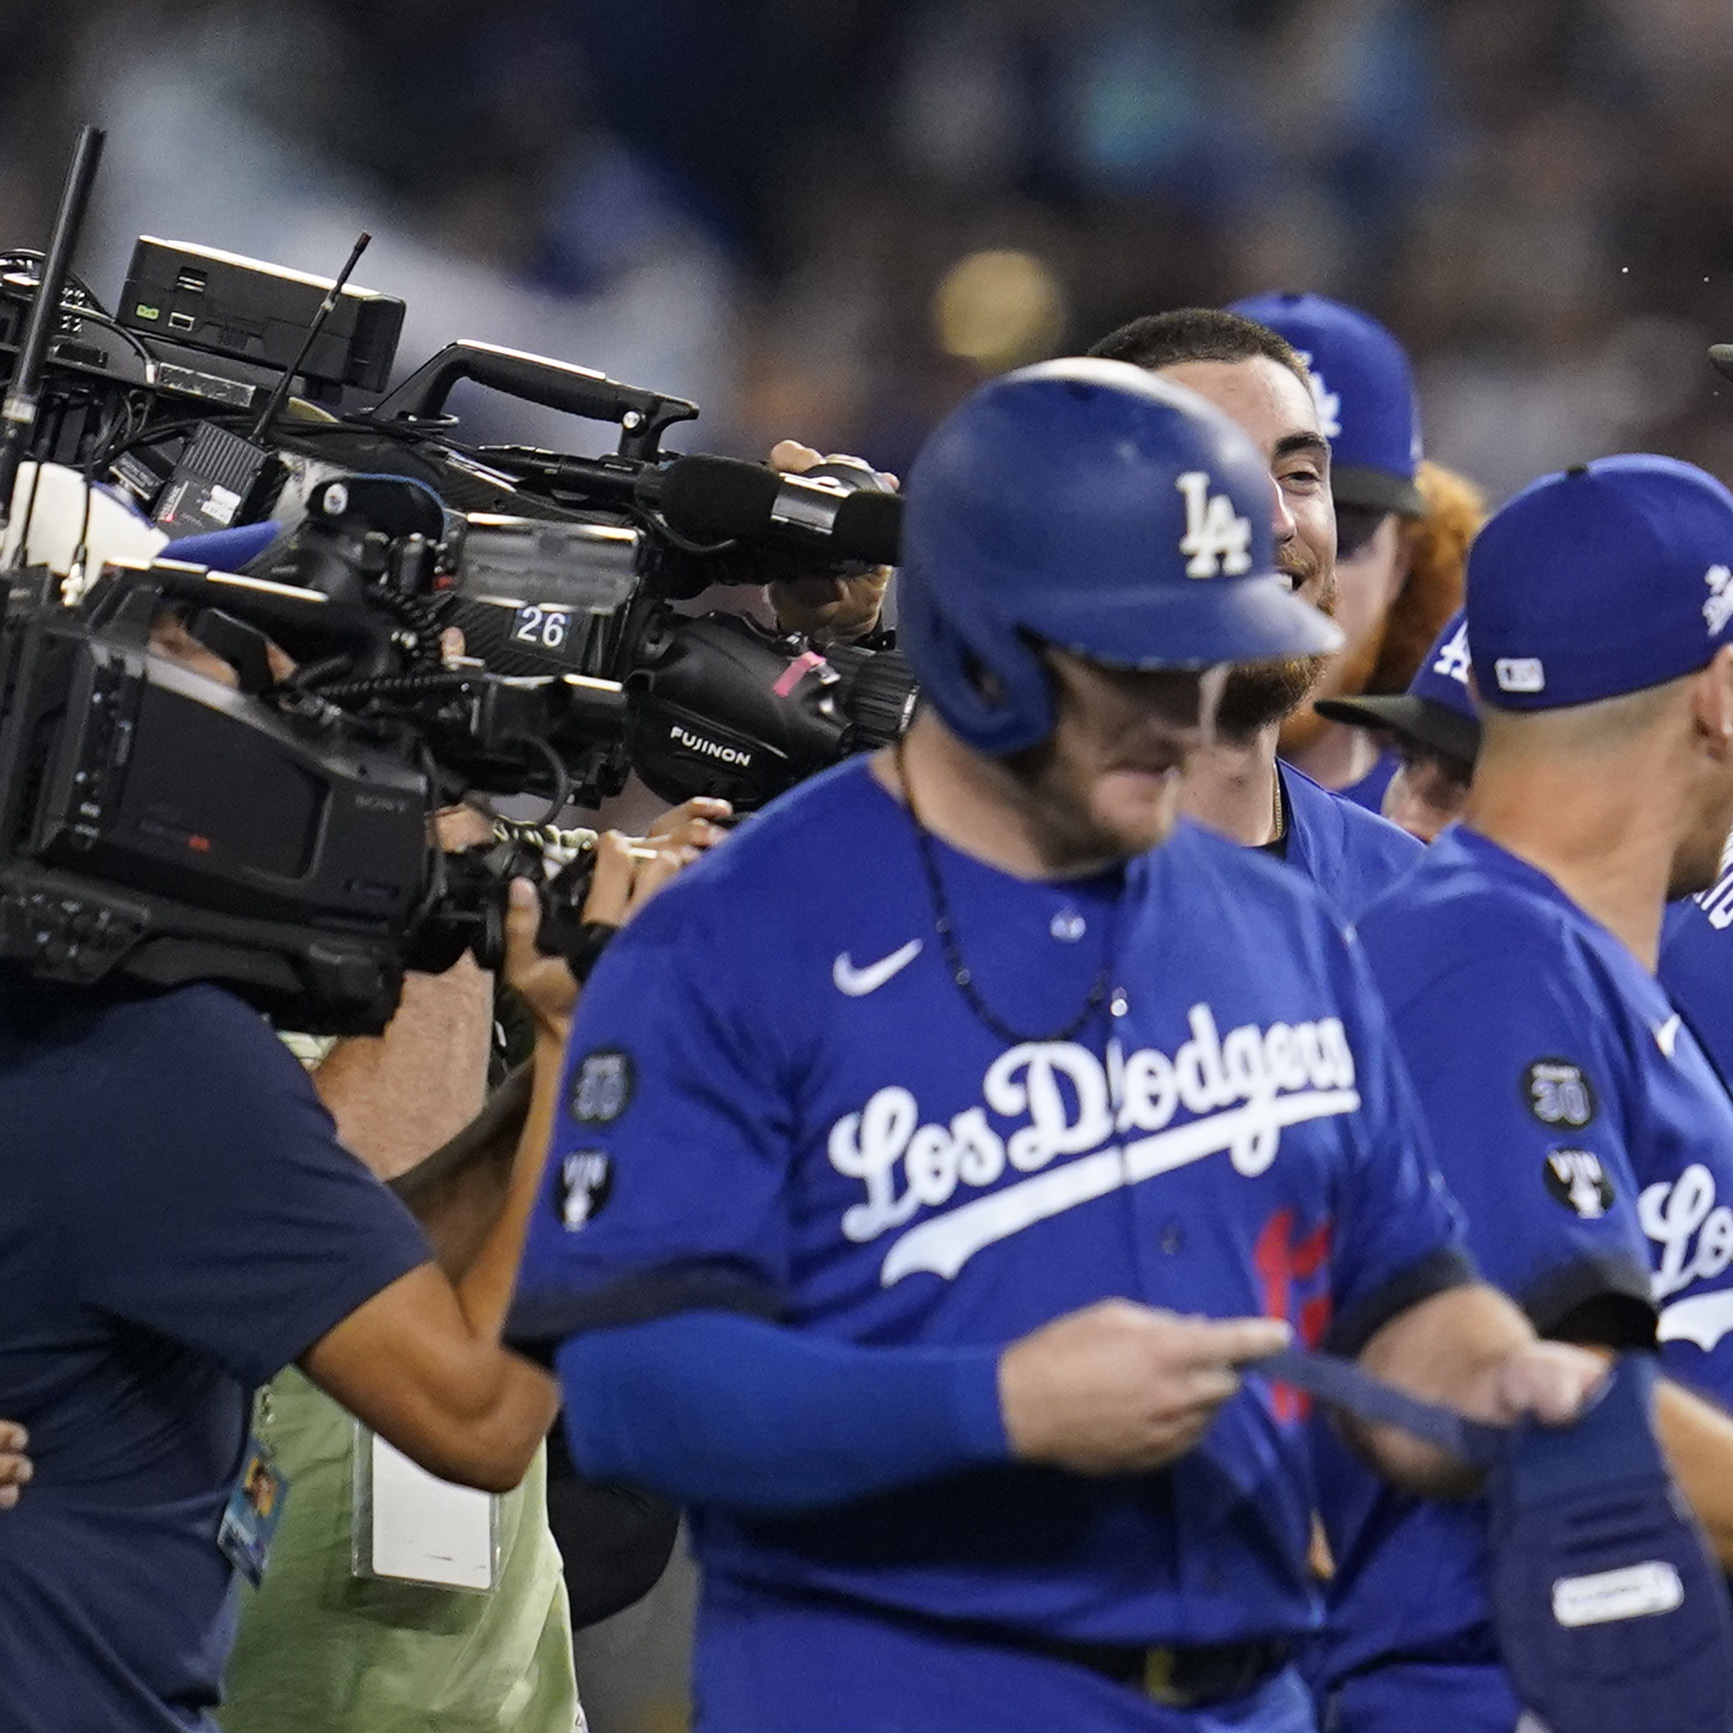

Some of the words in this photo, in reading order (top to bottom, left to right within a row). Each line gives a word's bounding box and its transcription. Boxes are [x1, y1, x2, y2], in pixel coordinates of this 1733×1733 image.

[1175, 471, 1252, 579] LA
[516, 606, 567, 648] 26
[670, 726, 751, 767] FUJINON
[828, 1085, 1006, 1242] Los
[983, 1002, 1356, 1177] Dodgers
